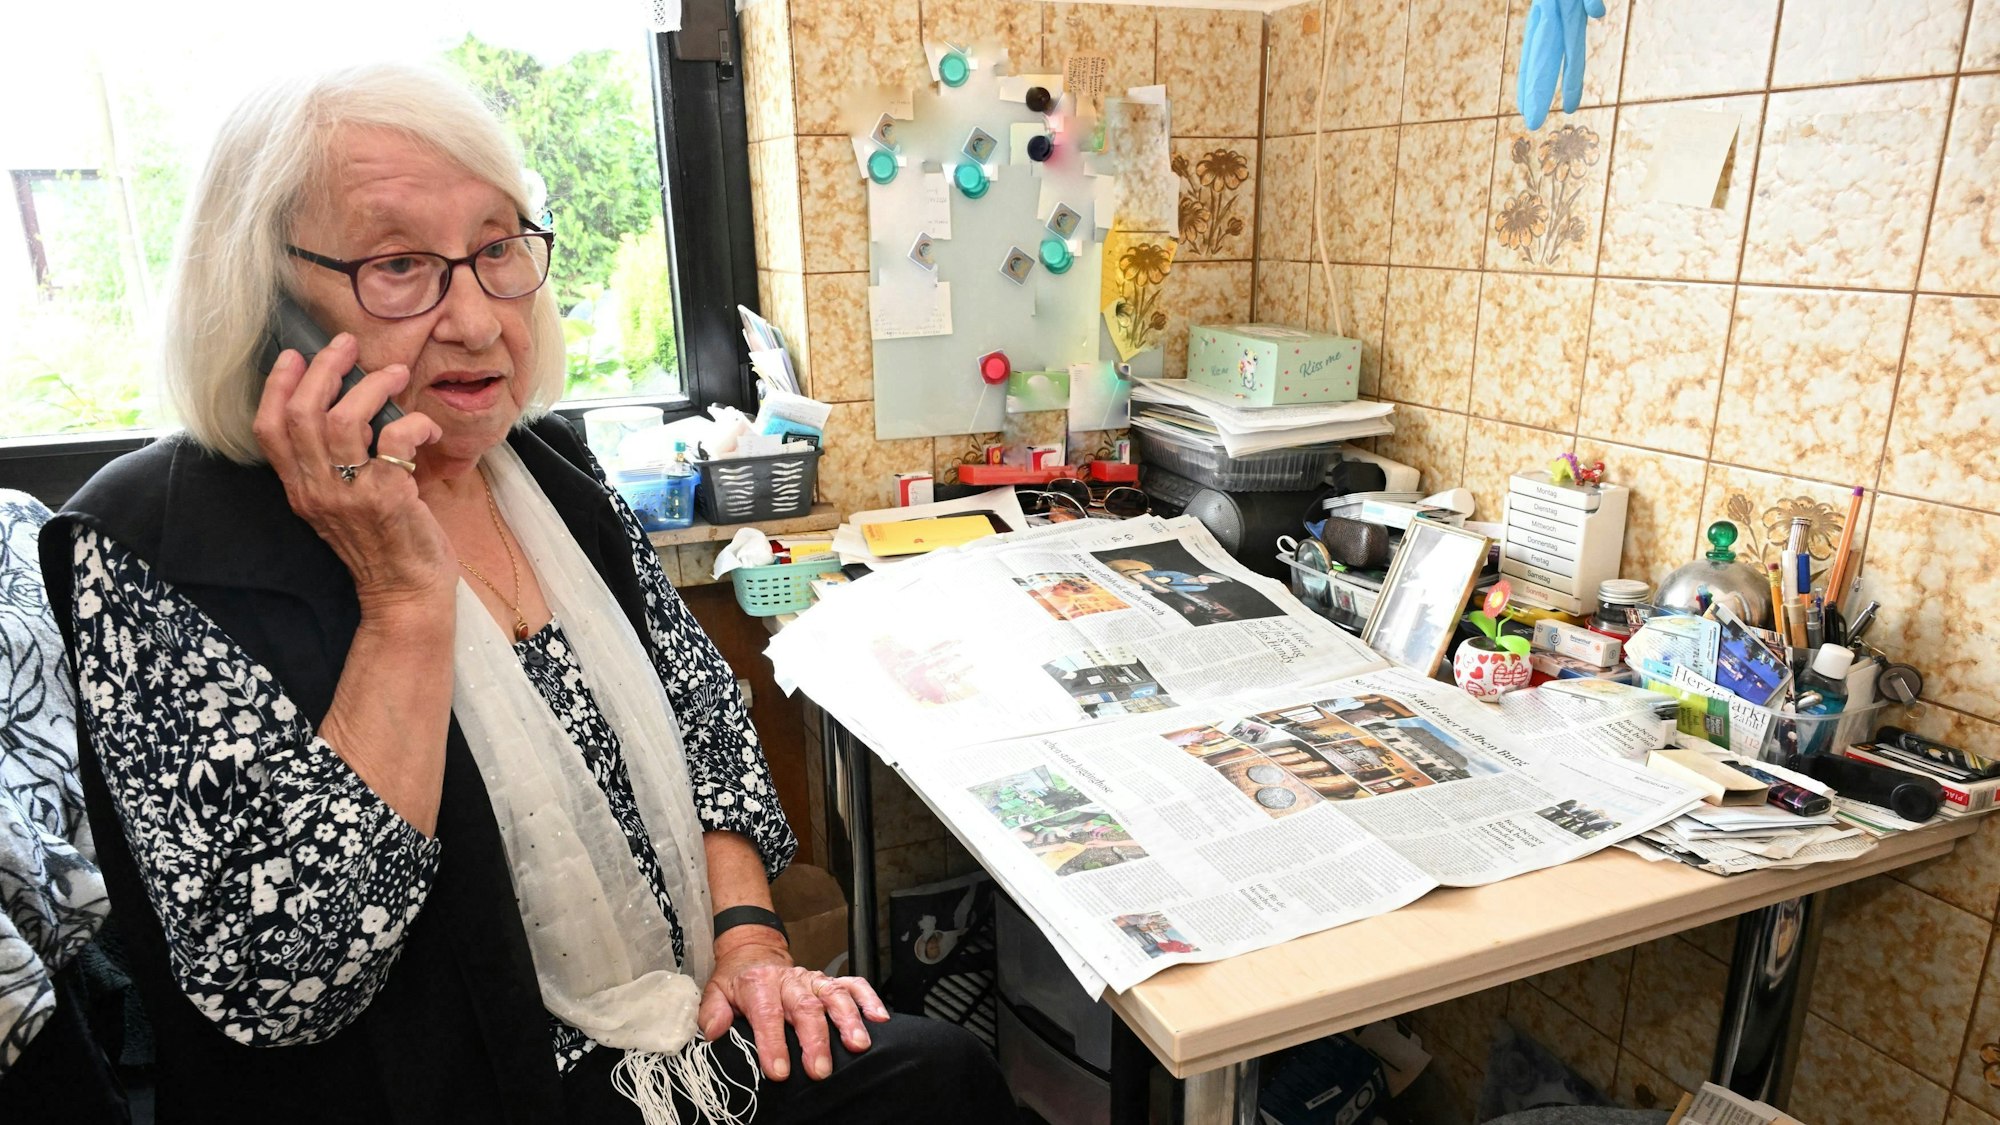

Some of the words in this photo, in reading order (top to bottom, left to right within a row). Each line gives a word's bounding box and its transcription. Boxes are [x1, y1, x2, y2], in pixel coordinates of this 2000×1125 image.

[1300, 360, 1323, 378] Kiss
[1325, 351, 1342, 366] me
[1537, 486, 1558, 498] Montag
[1534, 503, 1558, 516] Dienstag
[1531, 520, 1557, 532] Mittwoch
[1527, 536, 1558, 551] Donnerstag
[1530, 554, 1550, 566] Freitag
[1527, 569, 1551, 584] Samstag
[1525, 586, 1548, 600] Sonntag
[1267, 641, 1295, 664] Handy
[1277, 637, 1306, 658] genug
[1673, 665, 1766, 723] Herziarkt
[1415, 698, 1434, 711] auf
[1431, 707, 1461, 728] einer
[1459, 727, 1498, 751] halben
[1497, 749, 1530, 767] Burg
[1597, 726, 1635, 750] zusammen
[1606, 723, 1634, 742] Kunden
[1744, 735, 1760, 750] 112
[1477, 826, 1515, 850] zusammen
